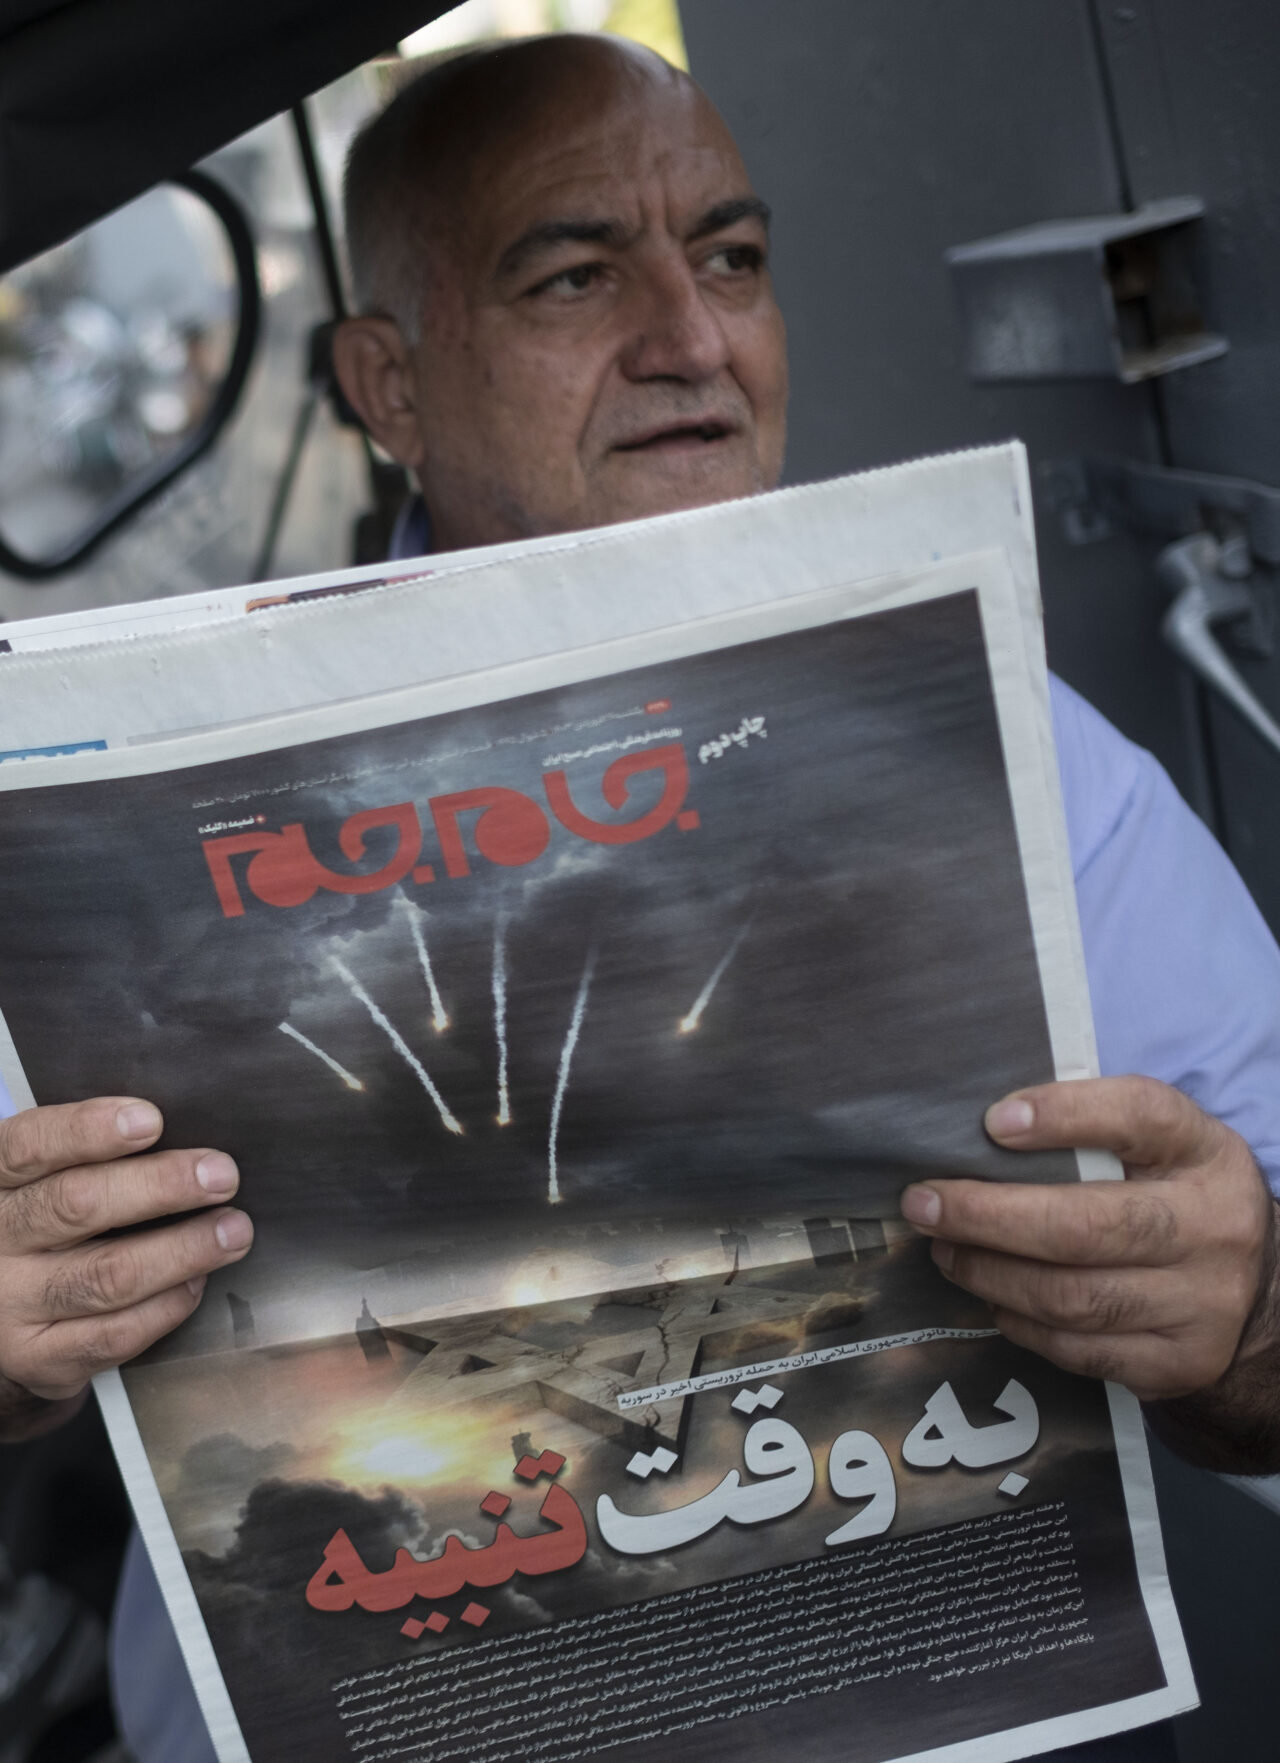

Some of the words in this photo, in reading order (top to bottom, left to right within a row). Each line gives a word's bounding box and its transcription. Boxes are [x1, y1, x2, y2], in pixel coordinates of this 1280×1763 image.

[729, 716, 768, 748] چاپ
[697, 733, 732, 765] دوم
[862, 1335, 909, 1353] جمهوری
[912, 1329, 947, 1343] قانونی
[792, 1352, 818, 1367] ایران
[820, 1343, 860, 1362] اسلامی
[745, 1363, 775, 1376] حمله
[778, 1360, 790, 1370] به
[670, 1380, 692, 1397] اخیر
[693, 1369, 743, 1390] تروریستی
[620, 1393, 653, 1405] سوریه
[656, 1388, 667, 1400] در
[901, 1377, 1041, 1496] به
[596, 1384, 899, 1555] وقت
[305, 1449, 588, 1640] تنبیه
